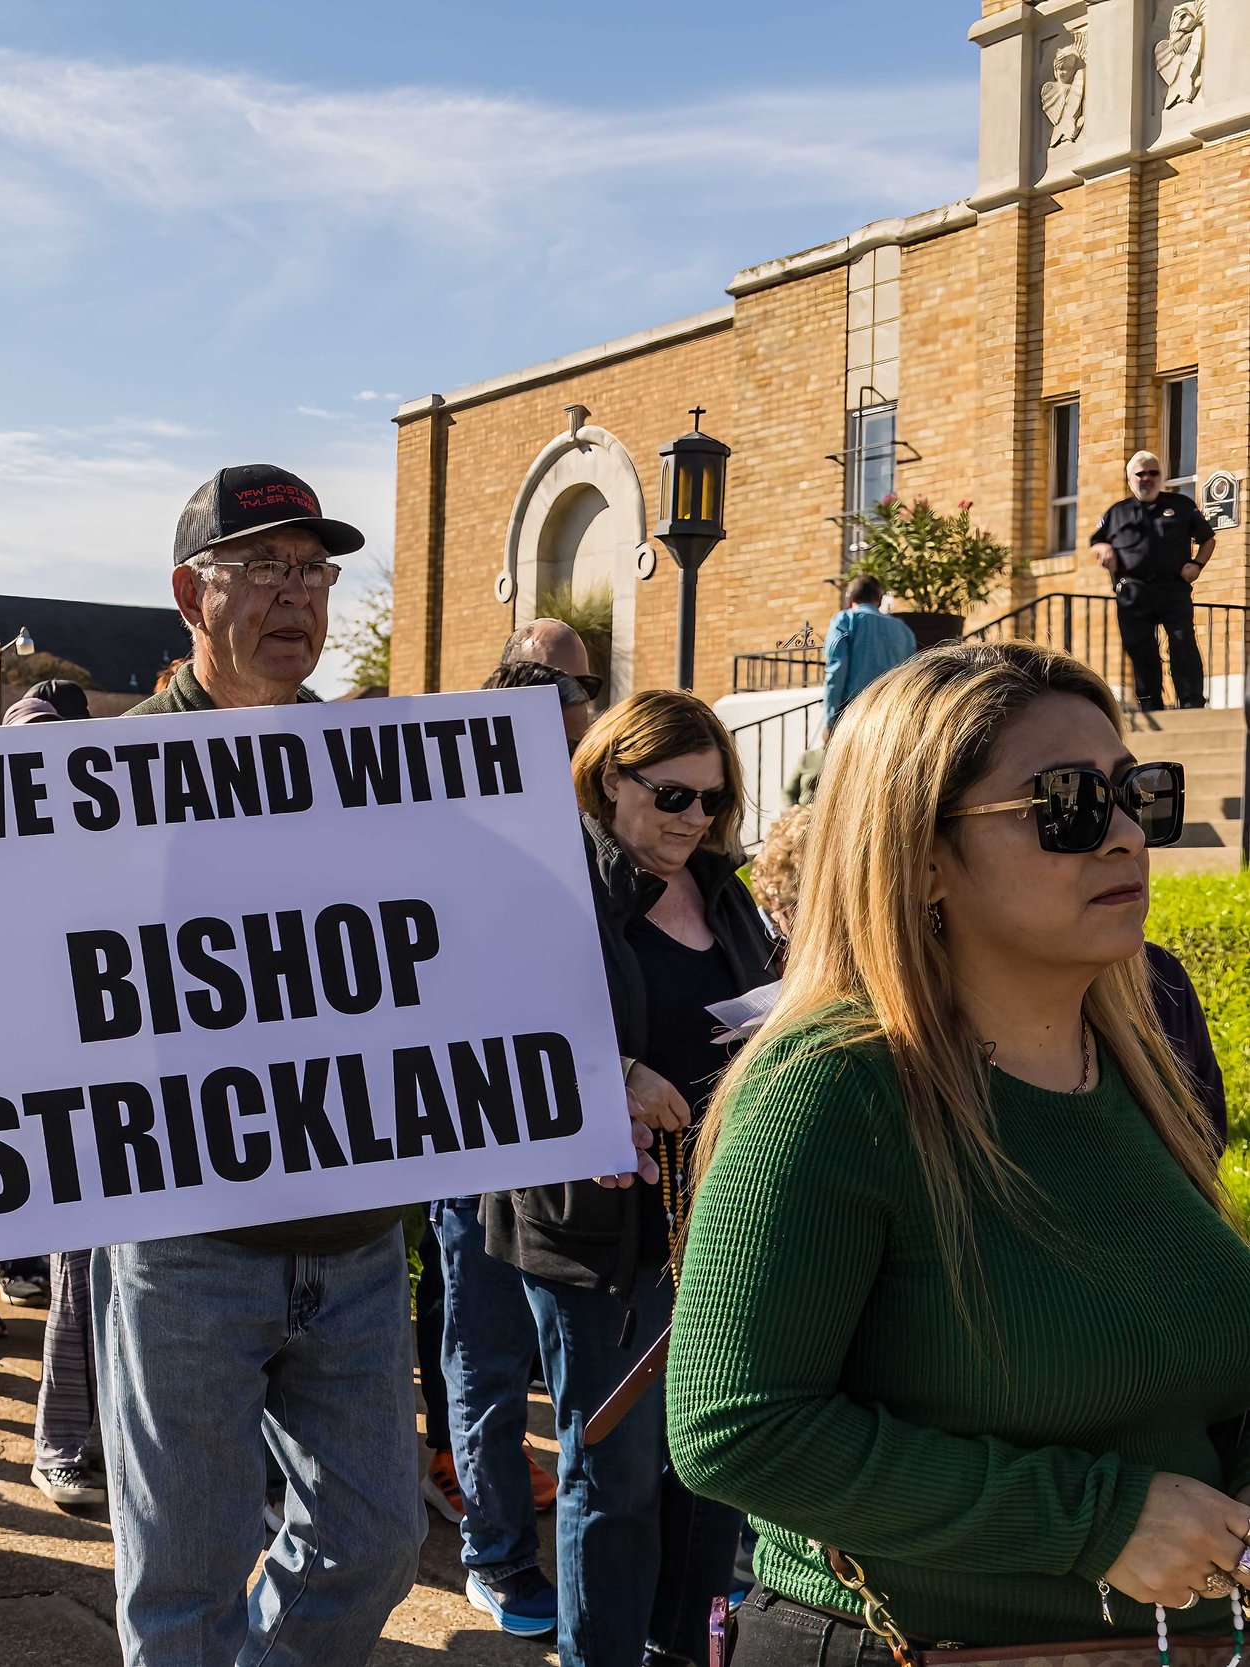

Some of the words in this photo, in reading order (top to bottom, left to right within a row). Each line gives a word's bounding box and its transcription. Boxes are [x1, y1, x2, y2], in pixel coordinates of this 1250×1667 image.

[234, 487, 264, 500] VFW
[266, 484, 299, 496] POST
[67, 732, 313, 832] STAND
[324, 715, 523, 808] WITH
[66, 898, 440, 1044] BISHOP
